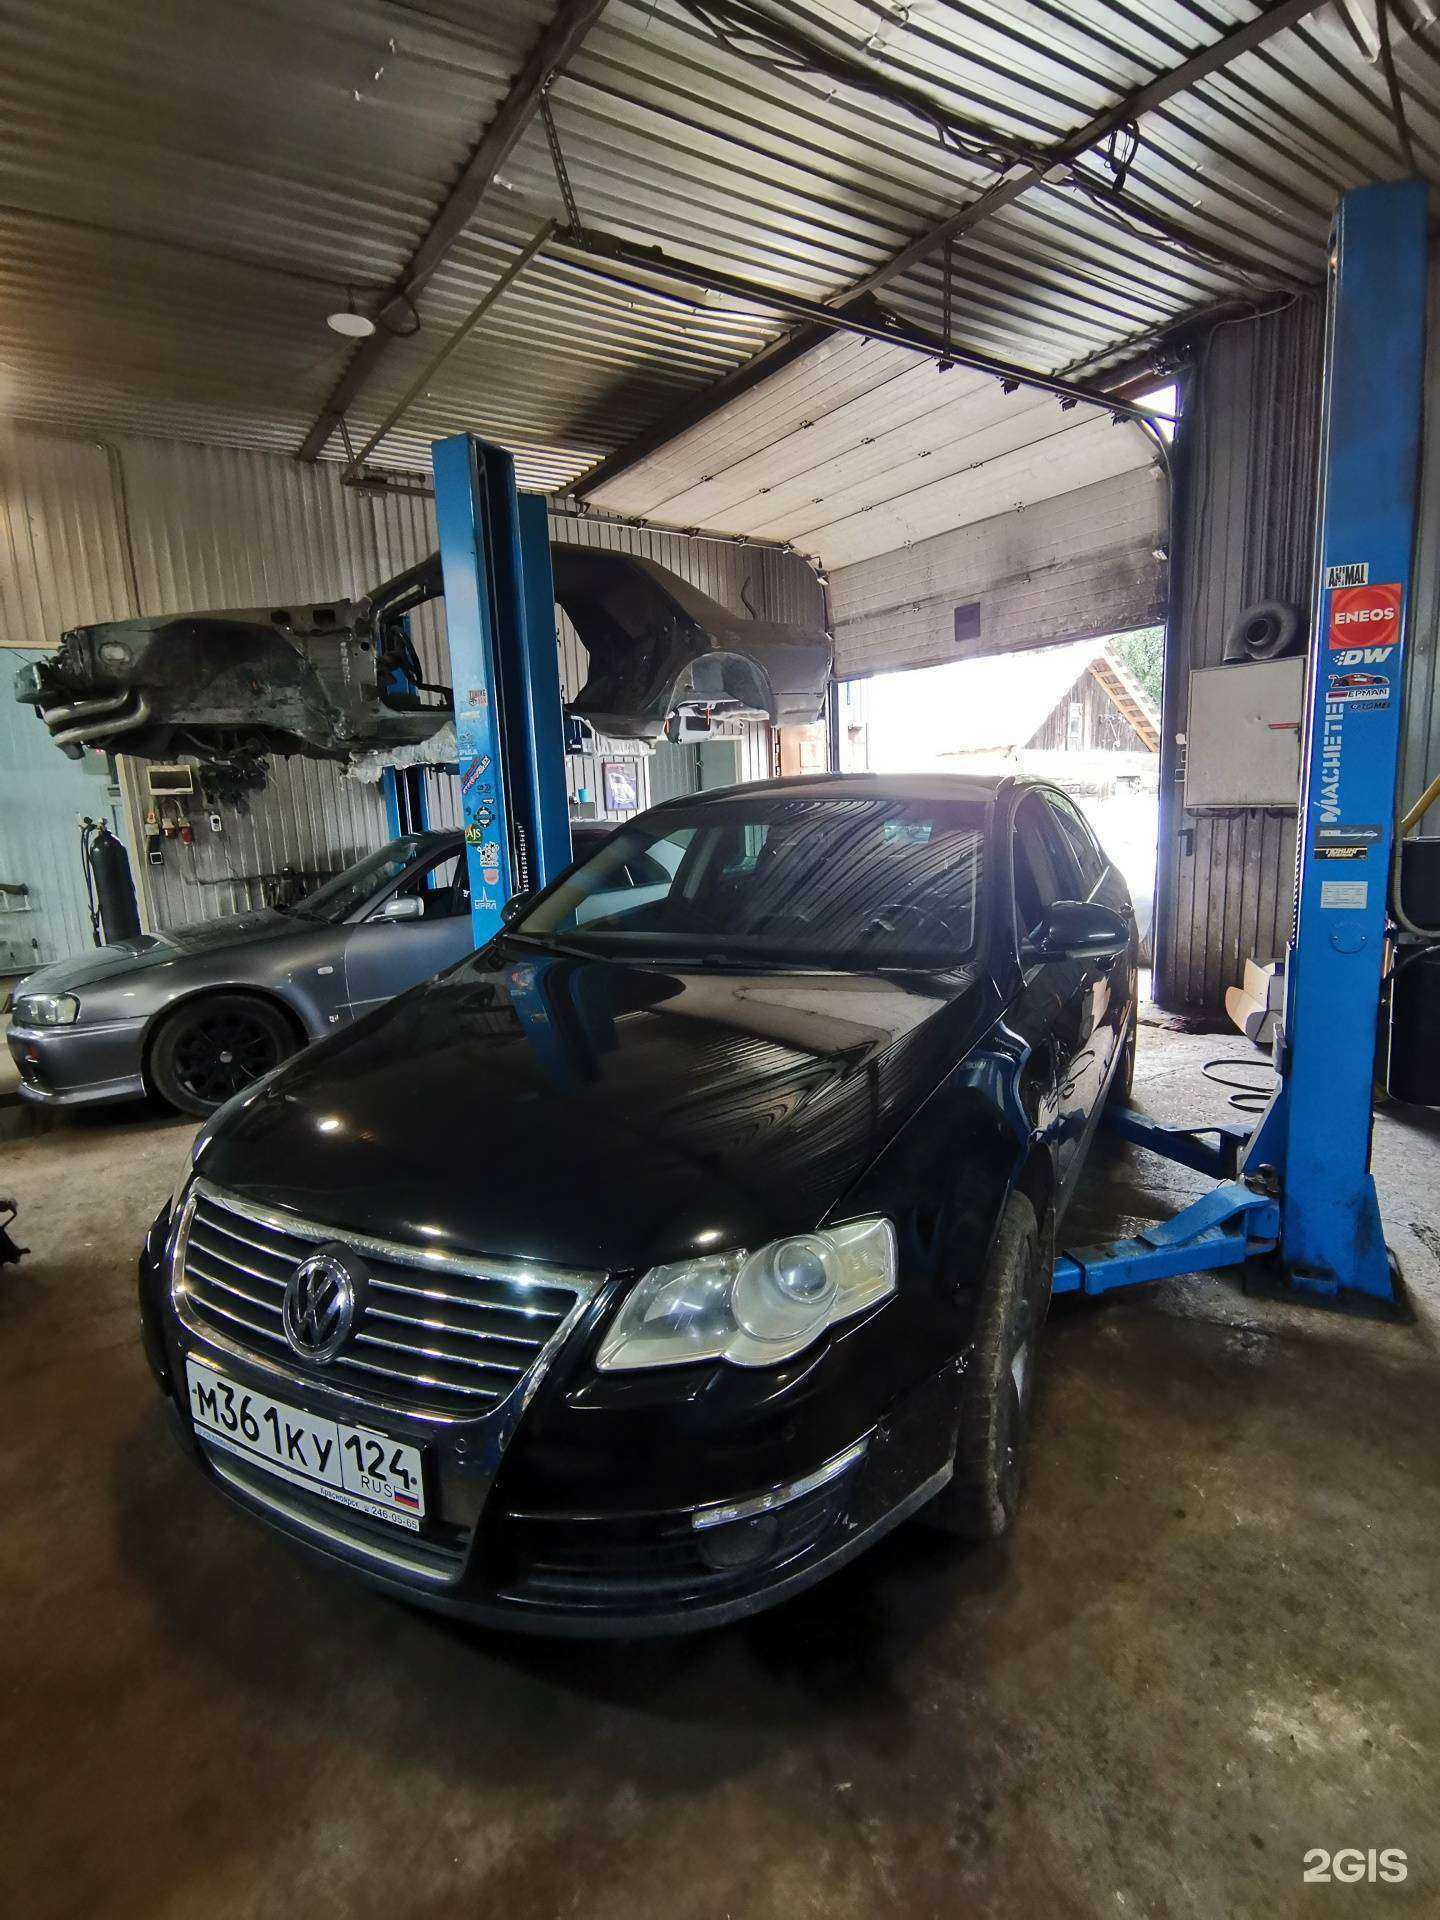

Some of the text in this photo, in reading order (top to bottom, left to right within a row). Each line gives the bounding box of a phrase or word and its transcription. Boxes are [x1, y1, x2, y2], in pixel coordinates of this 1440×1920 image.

[1327, 563, 1367, 587] ANIMAL
[1334, 607, 1395, 625] ENEOS
[1340, 647, 1393, 666] DW
[1316, 703, 1344, 823] MACHETE
[344, 1434, 410, 1490] 124
[361, 1474, 394, 1499] RUS
